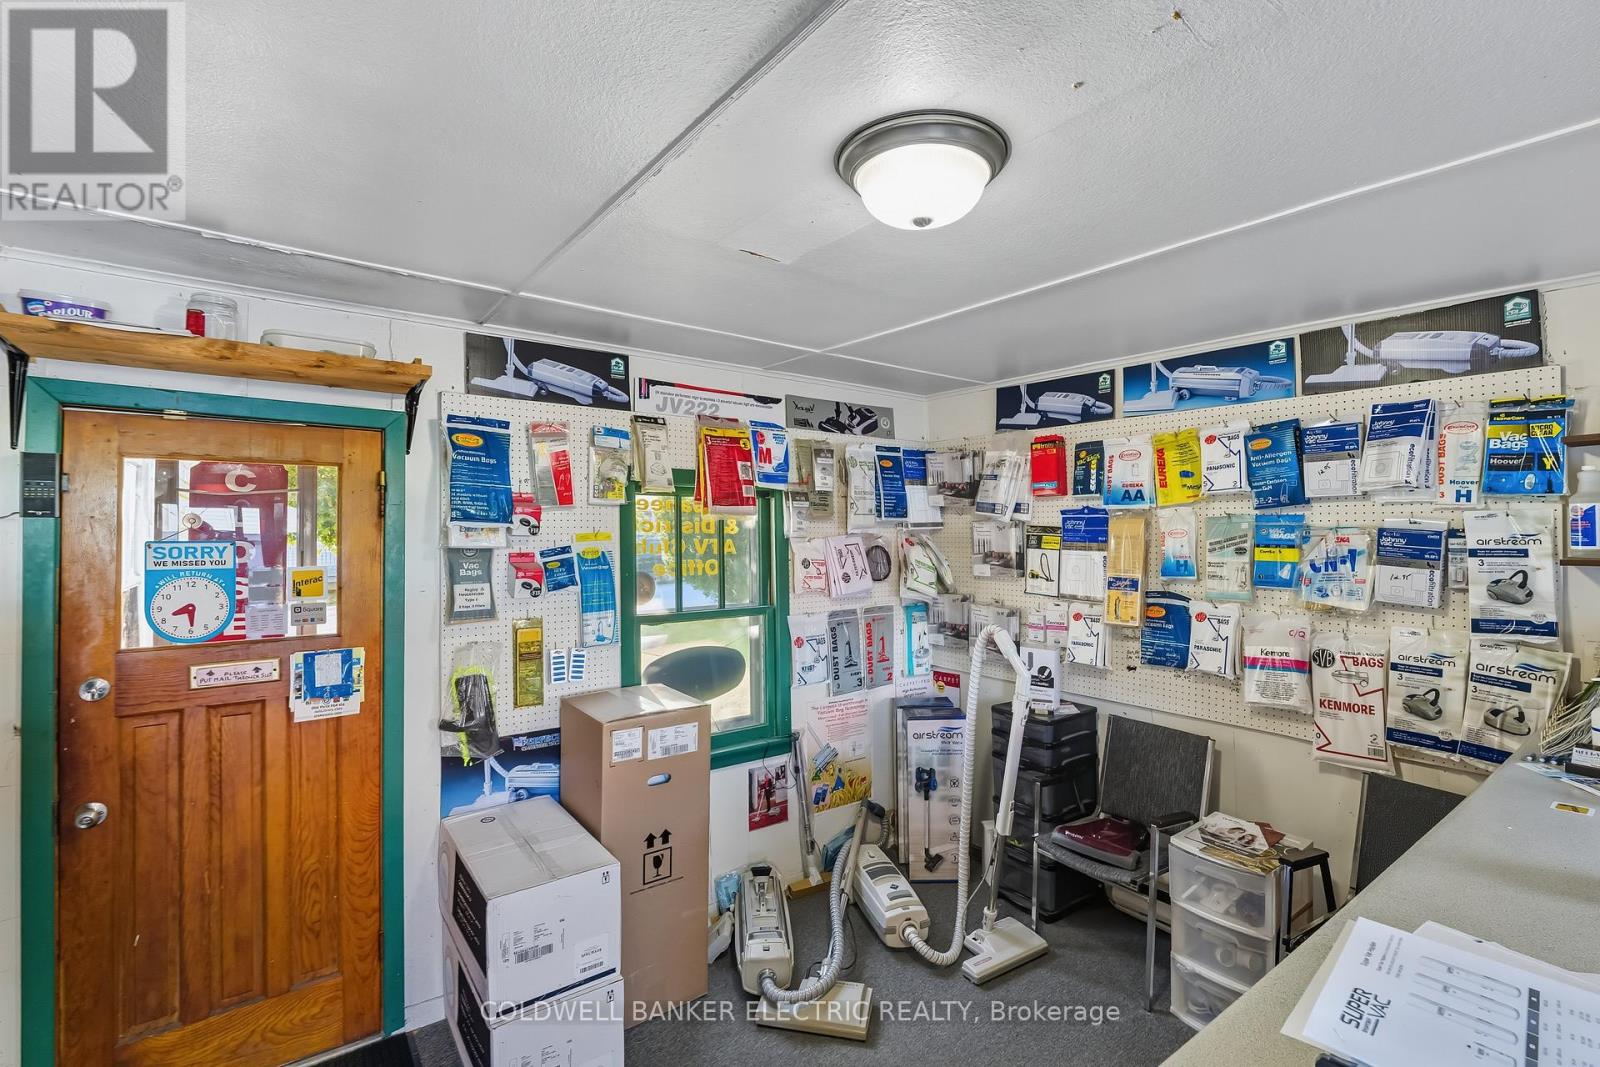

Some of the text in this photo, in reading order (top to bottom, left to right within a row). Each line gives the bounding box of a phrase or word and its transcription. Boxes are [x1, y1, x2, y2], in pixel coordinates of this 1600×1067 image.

[656, 396, 720, 416] JV222
[1499, 431, 1528, 441] Vac
[1438, 434, 1446, 459] BAGS
[1489, 439, 1528, 450] Bags
[452, 453, 480, 462] Vacuum
[759, 446, 772, 464] M
[1156, 448, 1168, 488] EUREKA
[1120, 489, 1145, 502] AA
[1455, 490, 1472, 502] H
[1476, 538, 1542, 546] airstream
[152, 546, 228, 560] SORRY
[460, 569, 482, 577] Bags
[292, 576, 323, 589] Interac
[1260, 648, 1290, 658] Kenmore
[1313, 650, 1334, 667] SVB
[1352, 657, 1384, 668] BAGS
[1398, 653, 1456, 668] airstream
[887, 672, 893, 681] 2
[934, 675, 959, 684] CARPET
[1476, 662, 1556, 684] airstream
[857, 677, 863, 686] 3
[1320, 698, 1375, 715] KENMORE
[913, 731, 963, 739] airstream
[1341, 987, 1373, 1029] SUPER
[1372, 994, 1391, 1019] VAC
